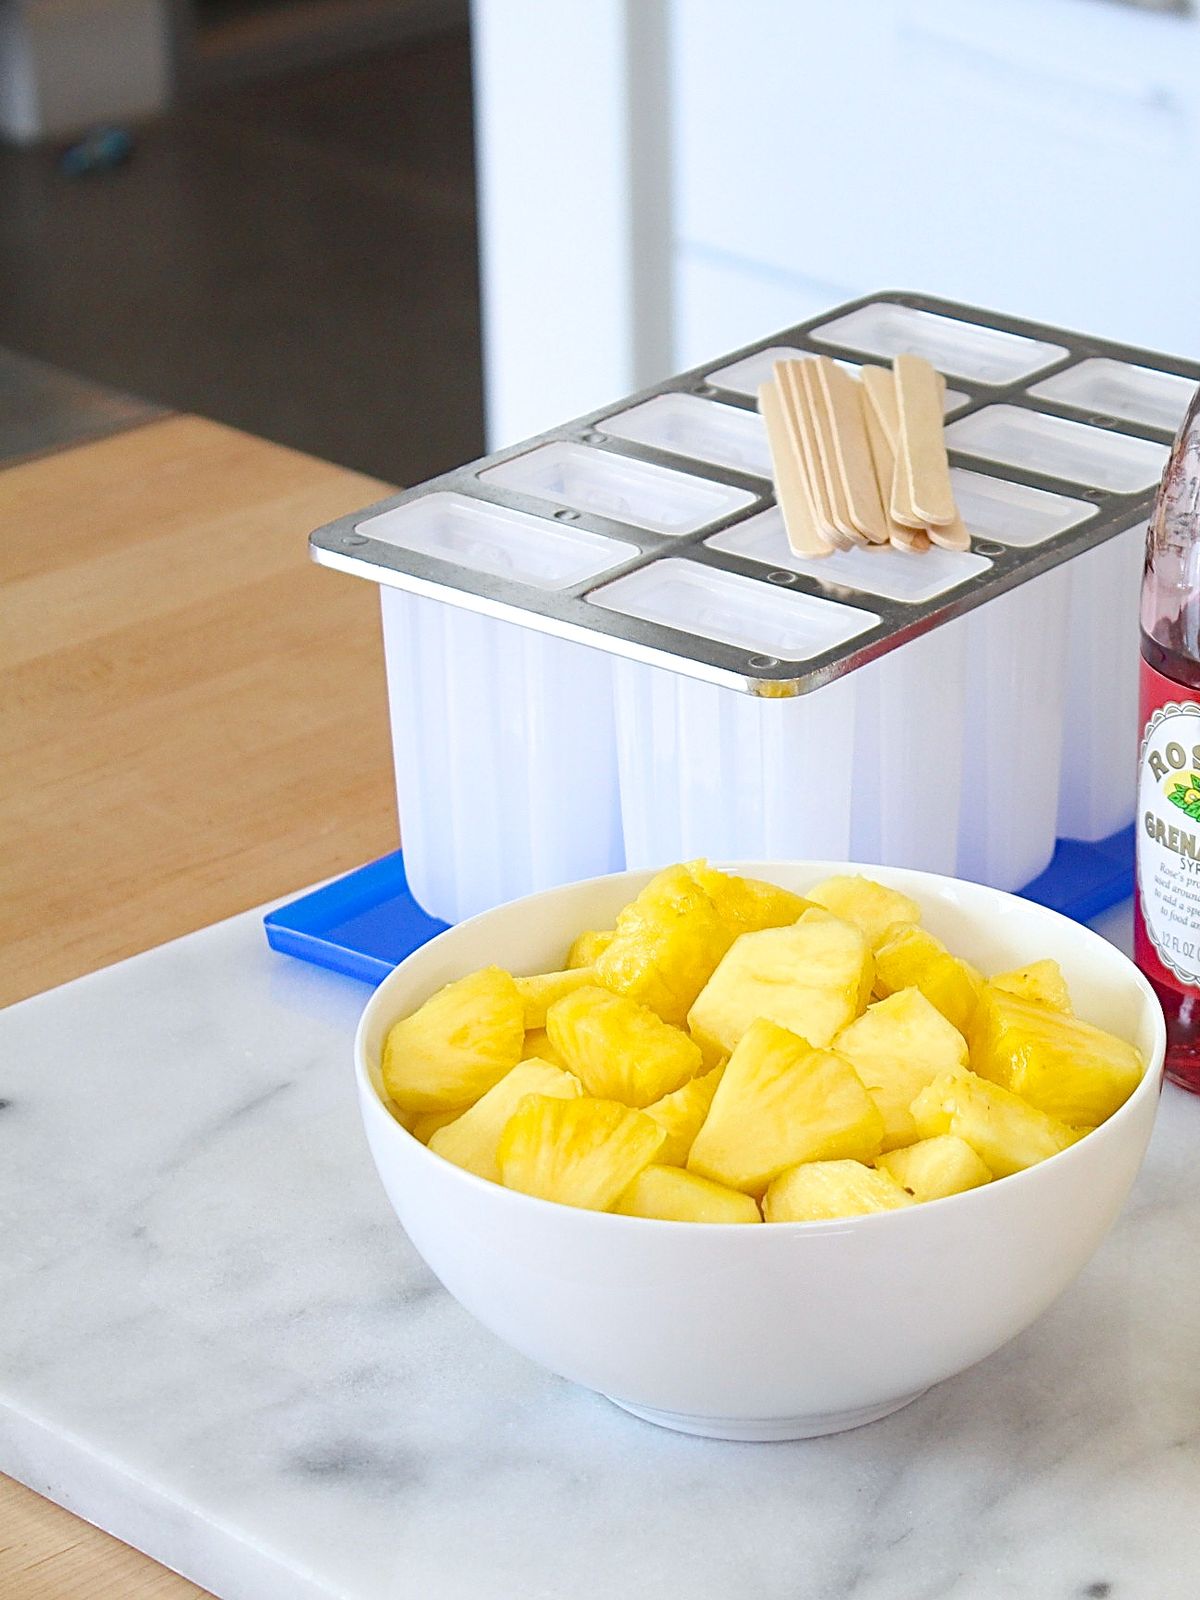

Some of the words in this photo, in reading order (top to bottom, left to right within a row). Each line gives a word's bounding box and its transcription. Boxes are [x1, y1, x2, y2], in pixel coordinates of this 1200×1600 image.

[1154, 875, 1171, 889] used
[1160, 862, 1184, 882] Rose's
[1154, 887, 1161, 898] to
[1163, 893, 1177, 907] add
[1161, 906, 1168, 916] to
[1168, 909, 1188, 925] food
[1162, 931, 1171, 948] 12
[1172, 936, 1181, 953] FL
[1182, 941, 1195, 958] OZ
